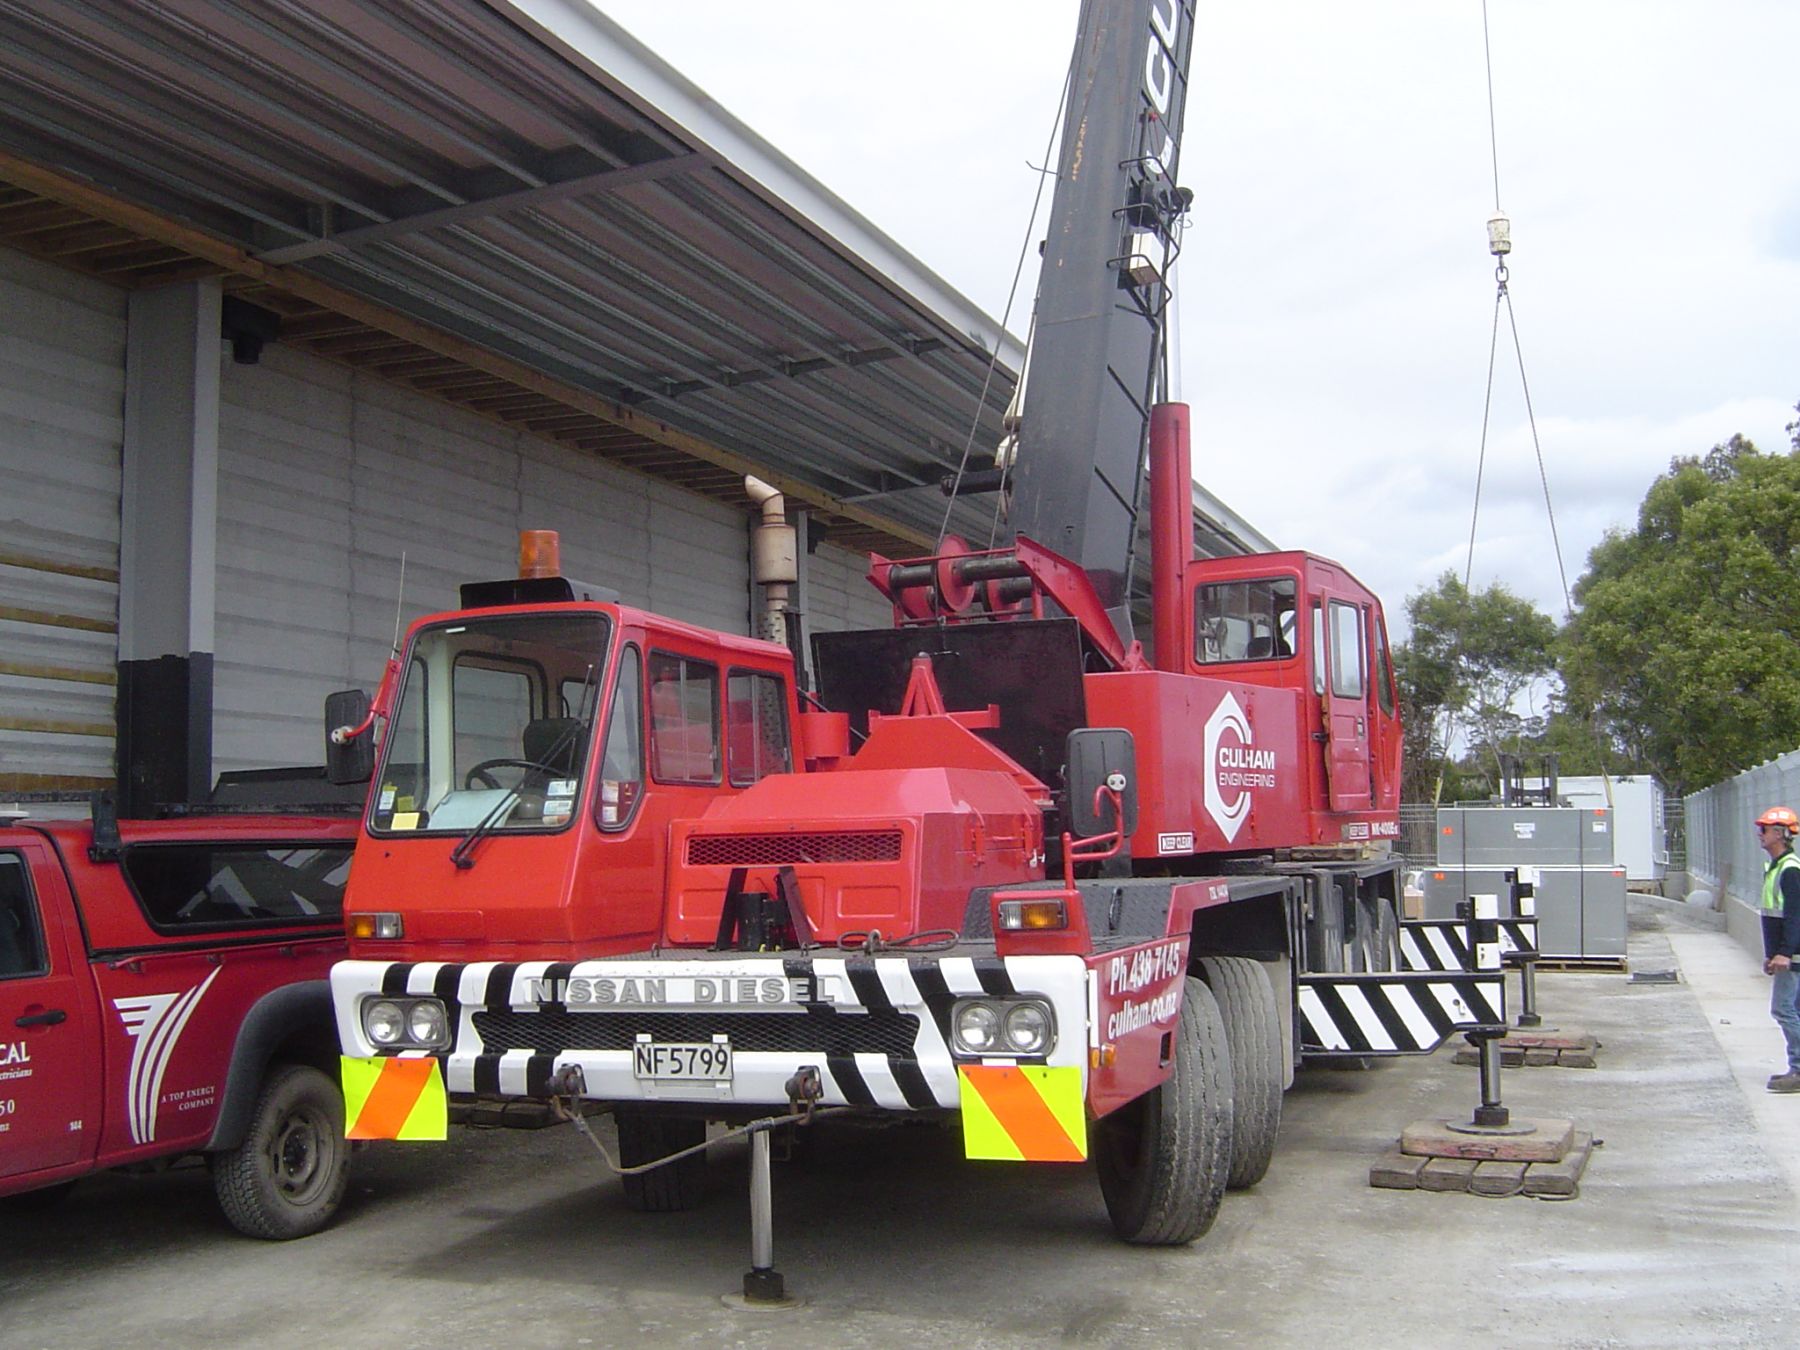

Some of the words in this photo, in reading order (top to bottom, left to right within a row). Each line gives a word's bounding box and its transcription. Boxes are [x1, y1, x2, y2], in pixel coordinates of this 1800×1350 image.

[1219, 747, 1275, 770] CULHAM
[1219, 772, 1275, 788] ENGINEERING
[1110, 956, 1127, 995] Ph
[1129, 950, 1152, 989] 438
[1154, 942, 1180, 981] 7145
[530, 978, 667, 1003] NISSAN
[694, 976, 836, 1002] DIESEL
[1108, 991, 1178, 1040] culham.co.nz
[636, 1046, 729, 1076] NF5799
[161, 1095, 167, 1104] A
[169, 1091, 185, 1102] TOP
[186, 1086, 215, 1098] ENERGY
[178, 1097, 214, 1111] COMPANY
